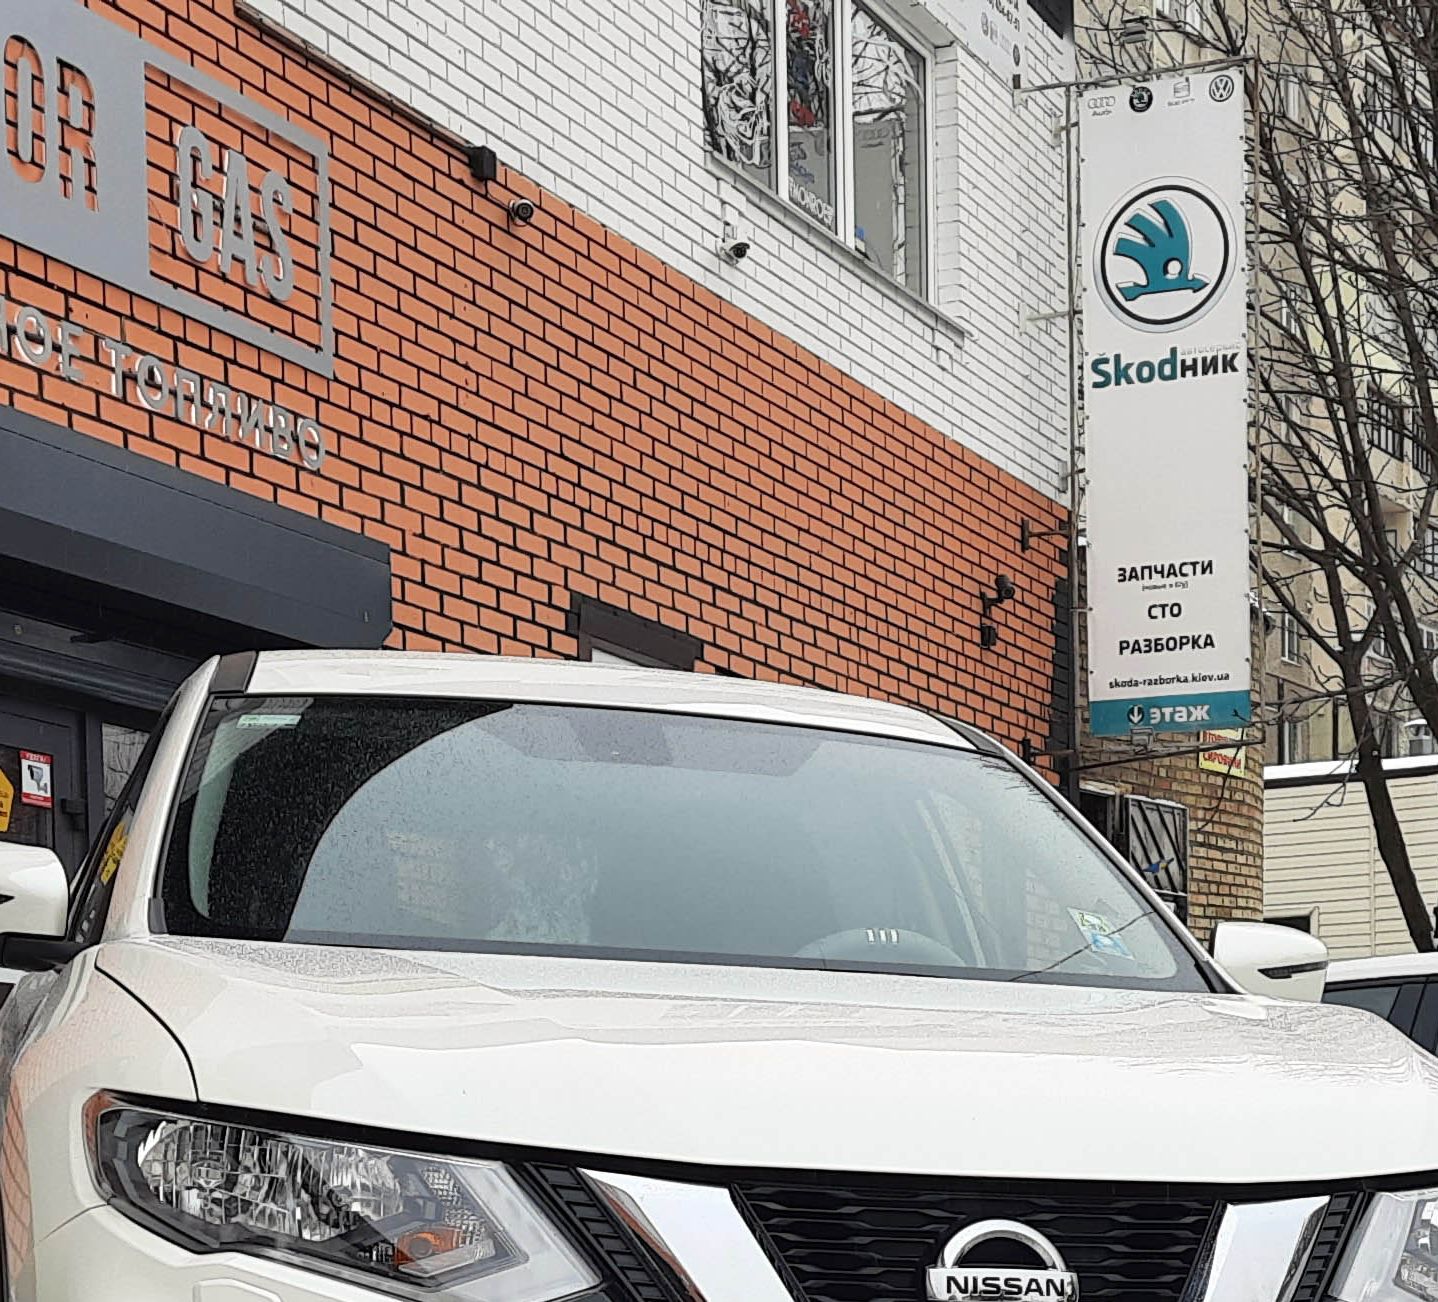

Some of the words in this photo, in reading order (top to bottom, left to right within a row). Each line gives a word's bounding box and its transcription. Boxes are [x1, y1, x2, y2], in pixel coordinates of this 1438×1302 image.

[175, 125, 294, 303] GAS
[100, 337, 326, 471] ТОПЛИВО
[1117, 559, 1213, 582] ЗАПЧАСТИ
[1147, 602, 1182, 619] СТО
[1119, 634, 1215, 655] РАЗБОРКА
[1109, 673, 1230, 689] skoda-razborka.kiev.ua
[1149, 705, 1211, 724] этаж
[946, 1275, 1064, 1297] NISSAN
